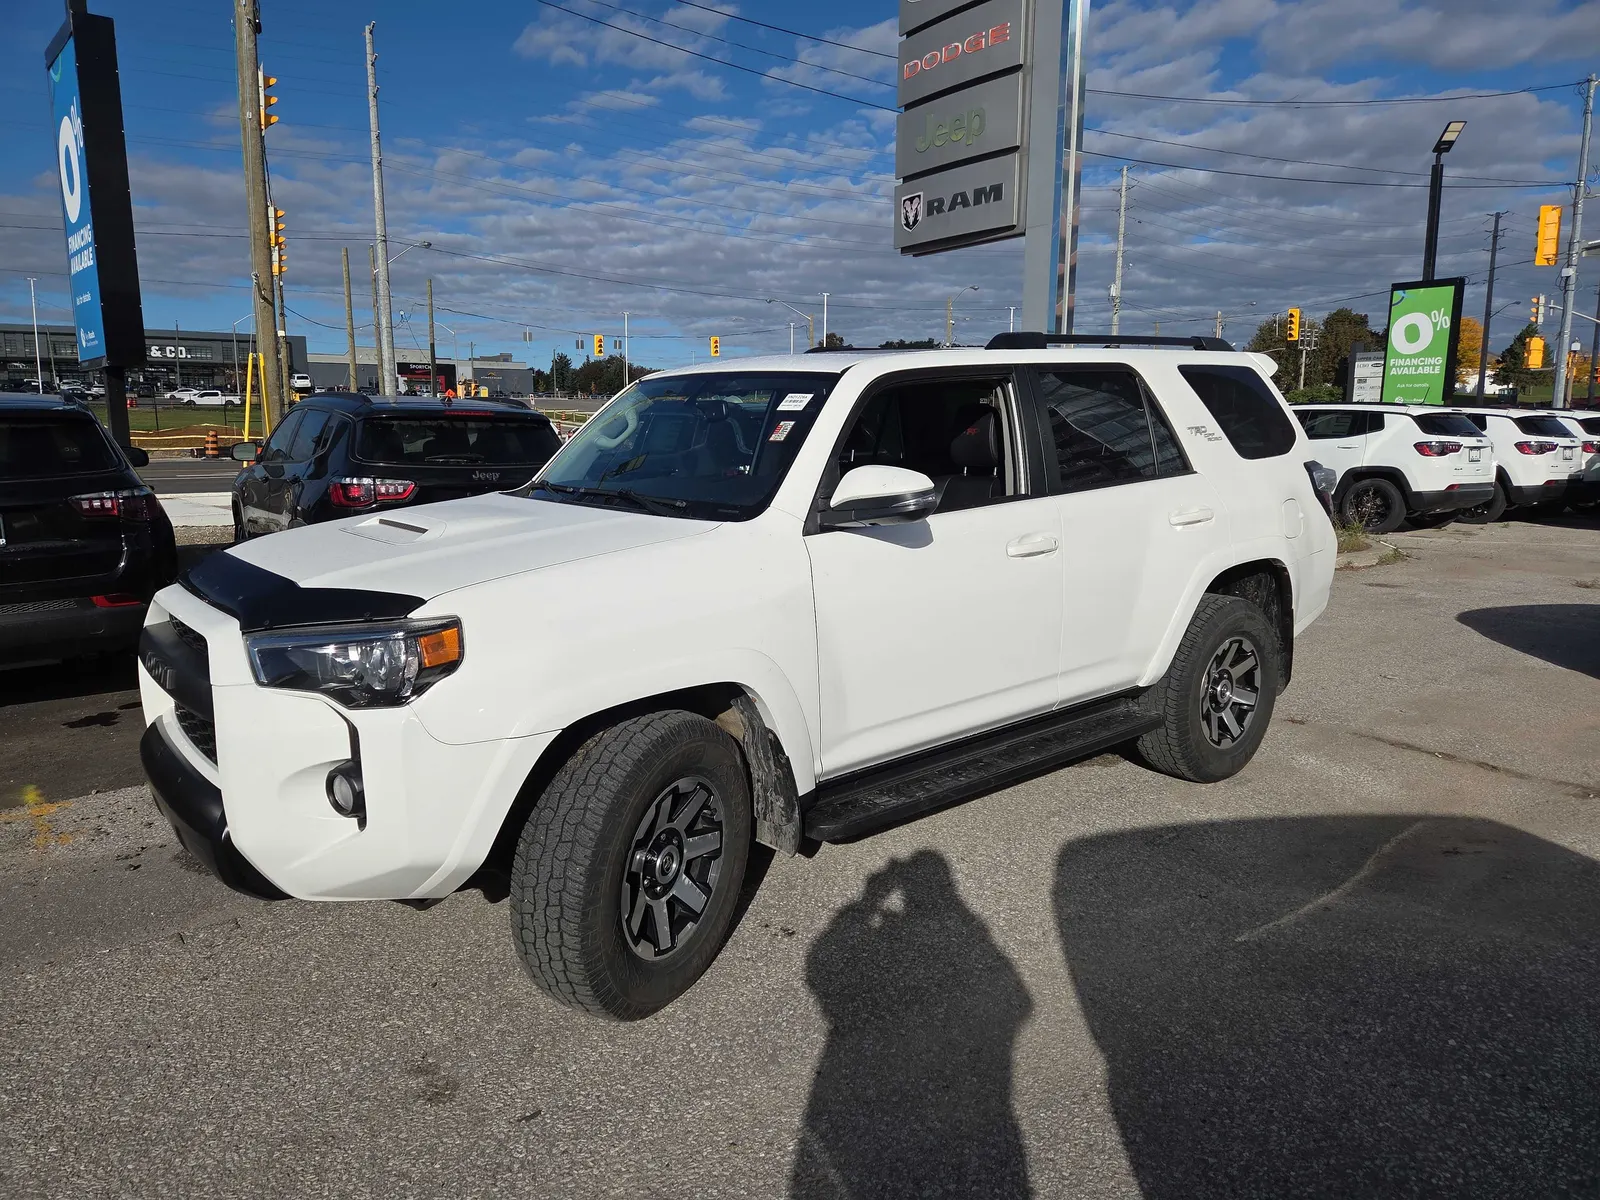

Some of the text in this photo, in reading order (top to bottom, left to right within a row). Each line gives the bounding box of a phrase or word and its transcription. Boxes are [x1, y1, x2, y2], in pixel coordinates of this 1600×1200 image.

[904, 22, 1010, 80] DODGE
[915, 107, 986, 153] Jeep
[59, 96, 83, 223] 0%
[926, 182, 1004, 217] RAM
[68, 223, 91, 255] FINANCING
[70, 246, 93, 276] AVAILABLE
[1391, 307, 1450, 355] 0%
[1390, 357, 1442, 366] FINANCING
[1390, 366, 1440, 375] AVAILABLE
[472, 470, 500, 481] Jeep
